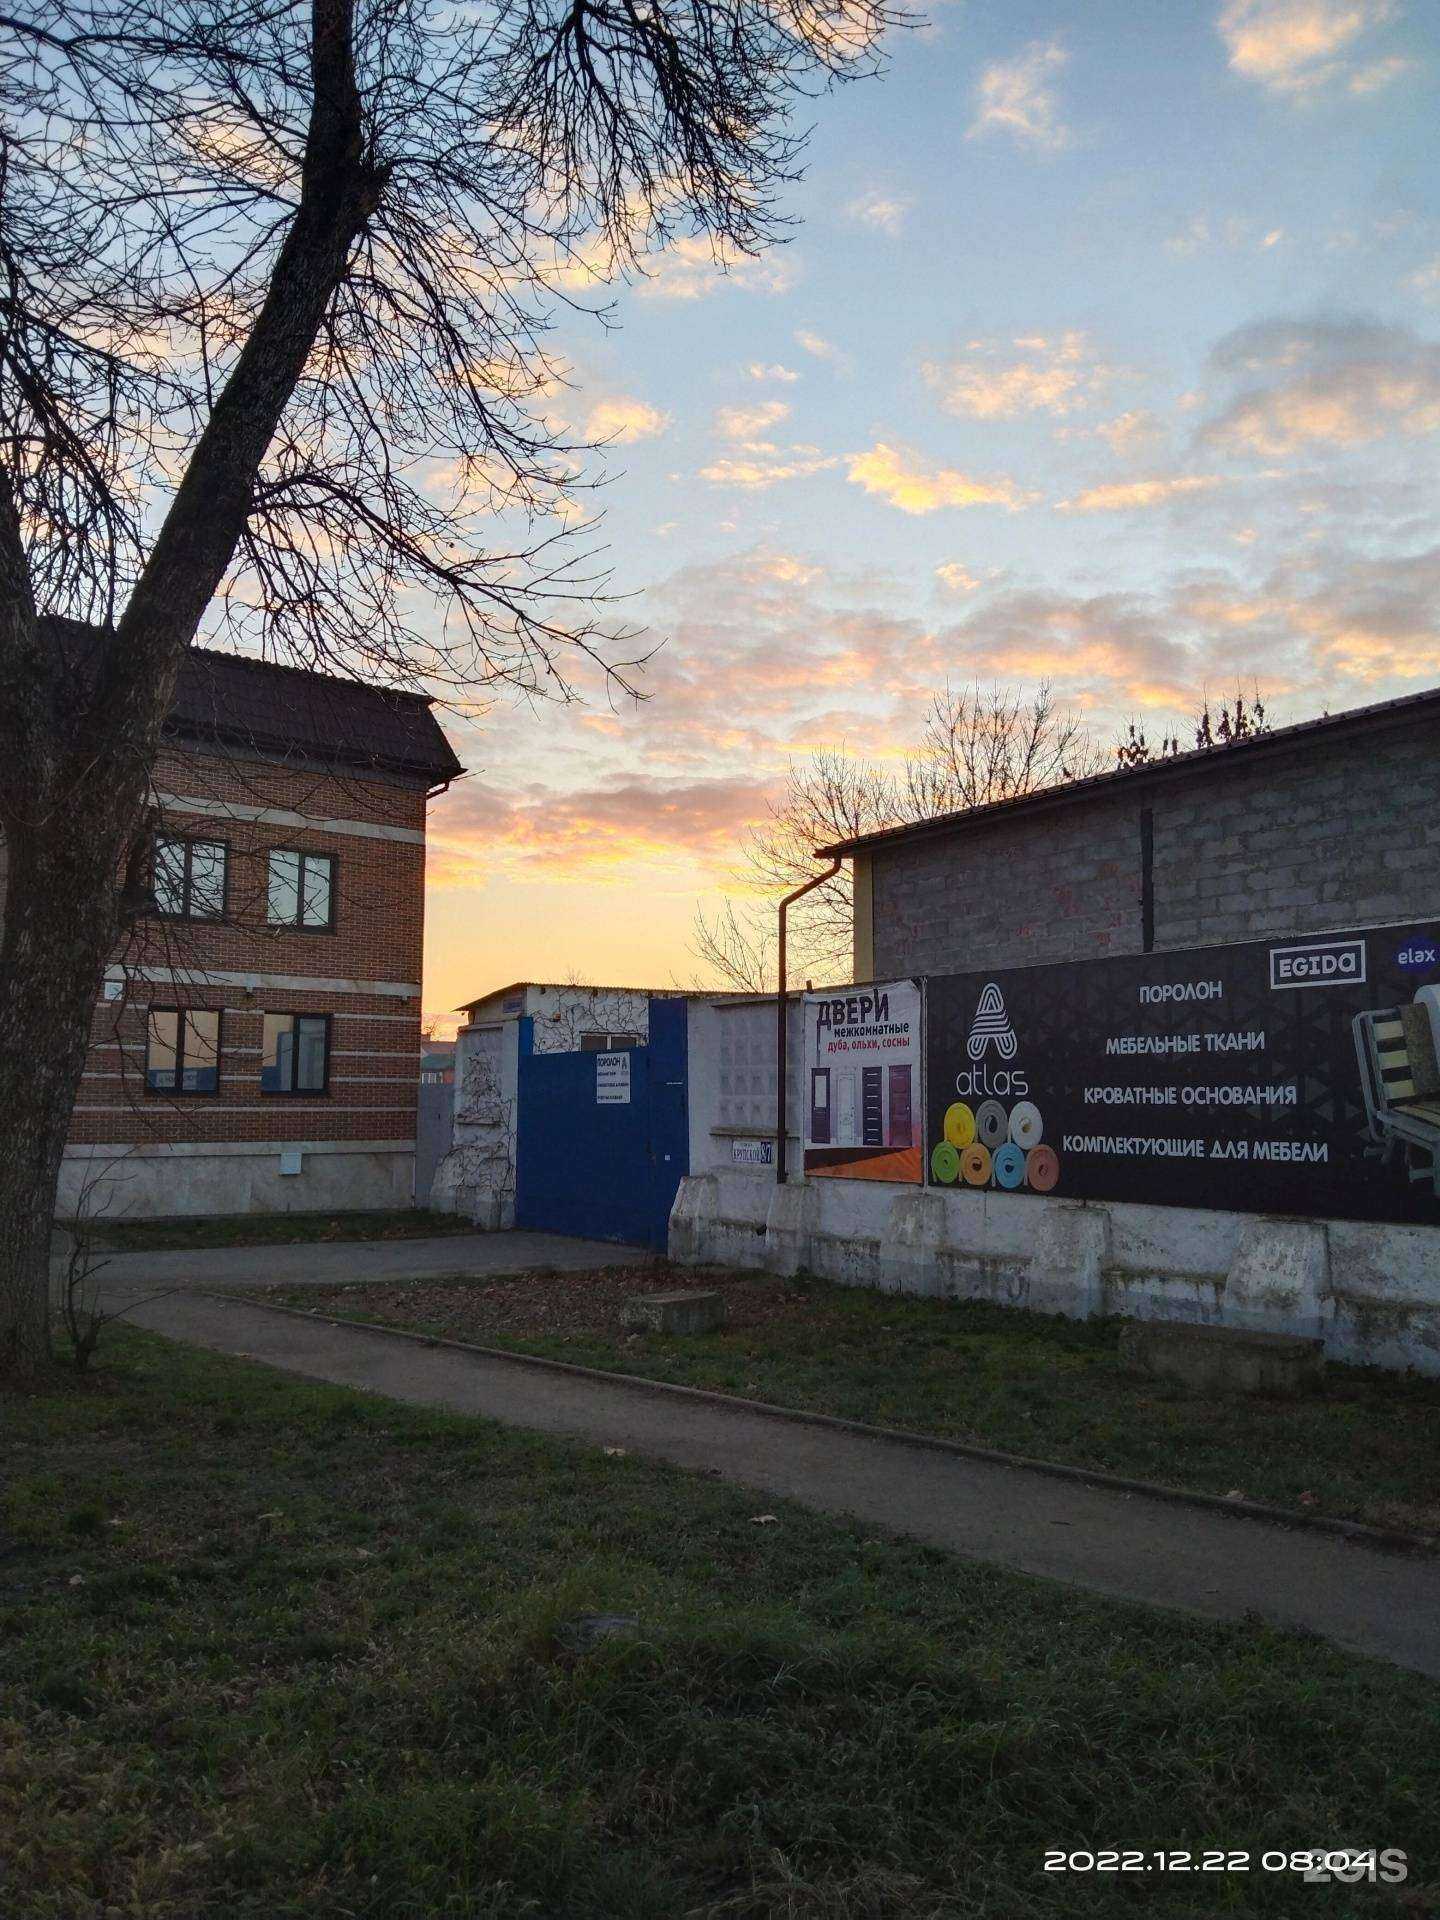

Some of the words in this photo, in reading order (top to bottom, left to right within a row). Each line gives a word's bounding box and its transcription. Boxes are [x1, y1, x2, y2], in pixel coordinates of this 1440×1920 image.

[1398, 948, 1436, 965] elax
[1138, 981, 1223, 1004] ПОРОЛОН
[816, 988, 889, 1030] ДВЕРИ
[834, 1021, 910, 1038] межкомнатные
[827, 1039, 850, 1054] дуба,
[882, 1036, 910, 1049] сосны
[1105, 1035, 1202, 1056] МЕБЕЛЬНЫЕ
[1204, 1031, 1266, 1053] ТКАНИ
[955, 1065, 1030, 1096] atlas
[1083, 1086, 1178, 1106] КРОВАТНЫЕ
[1181, 1085, 1298, 1106] ОСНОВАНИЯ
[1062, 1135, 1205, 1158] КОМПЛЕКТУЮЩИЕ
[1209, 1139, 1249, 1160] ДЛЯ
[1252, 1141, 1328, 1163] МЕБЕЛИ
